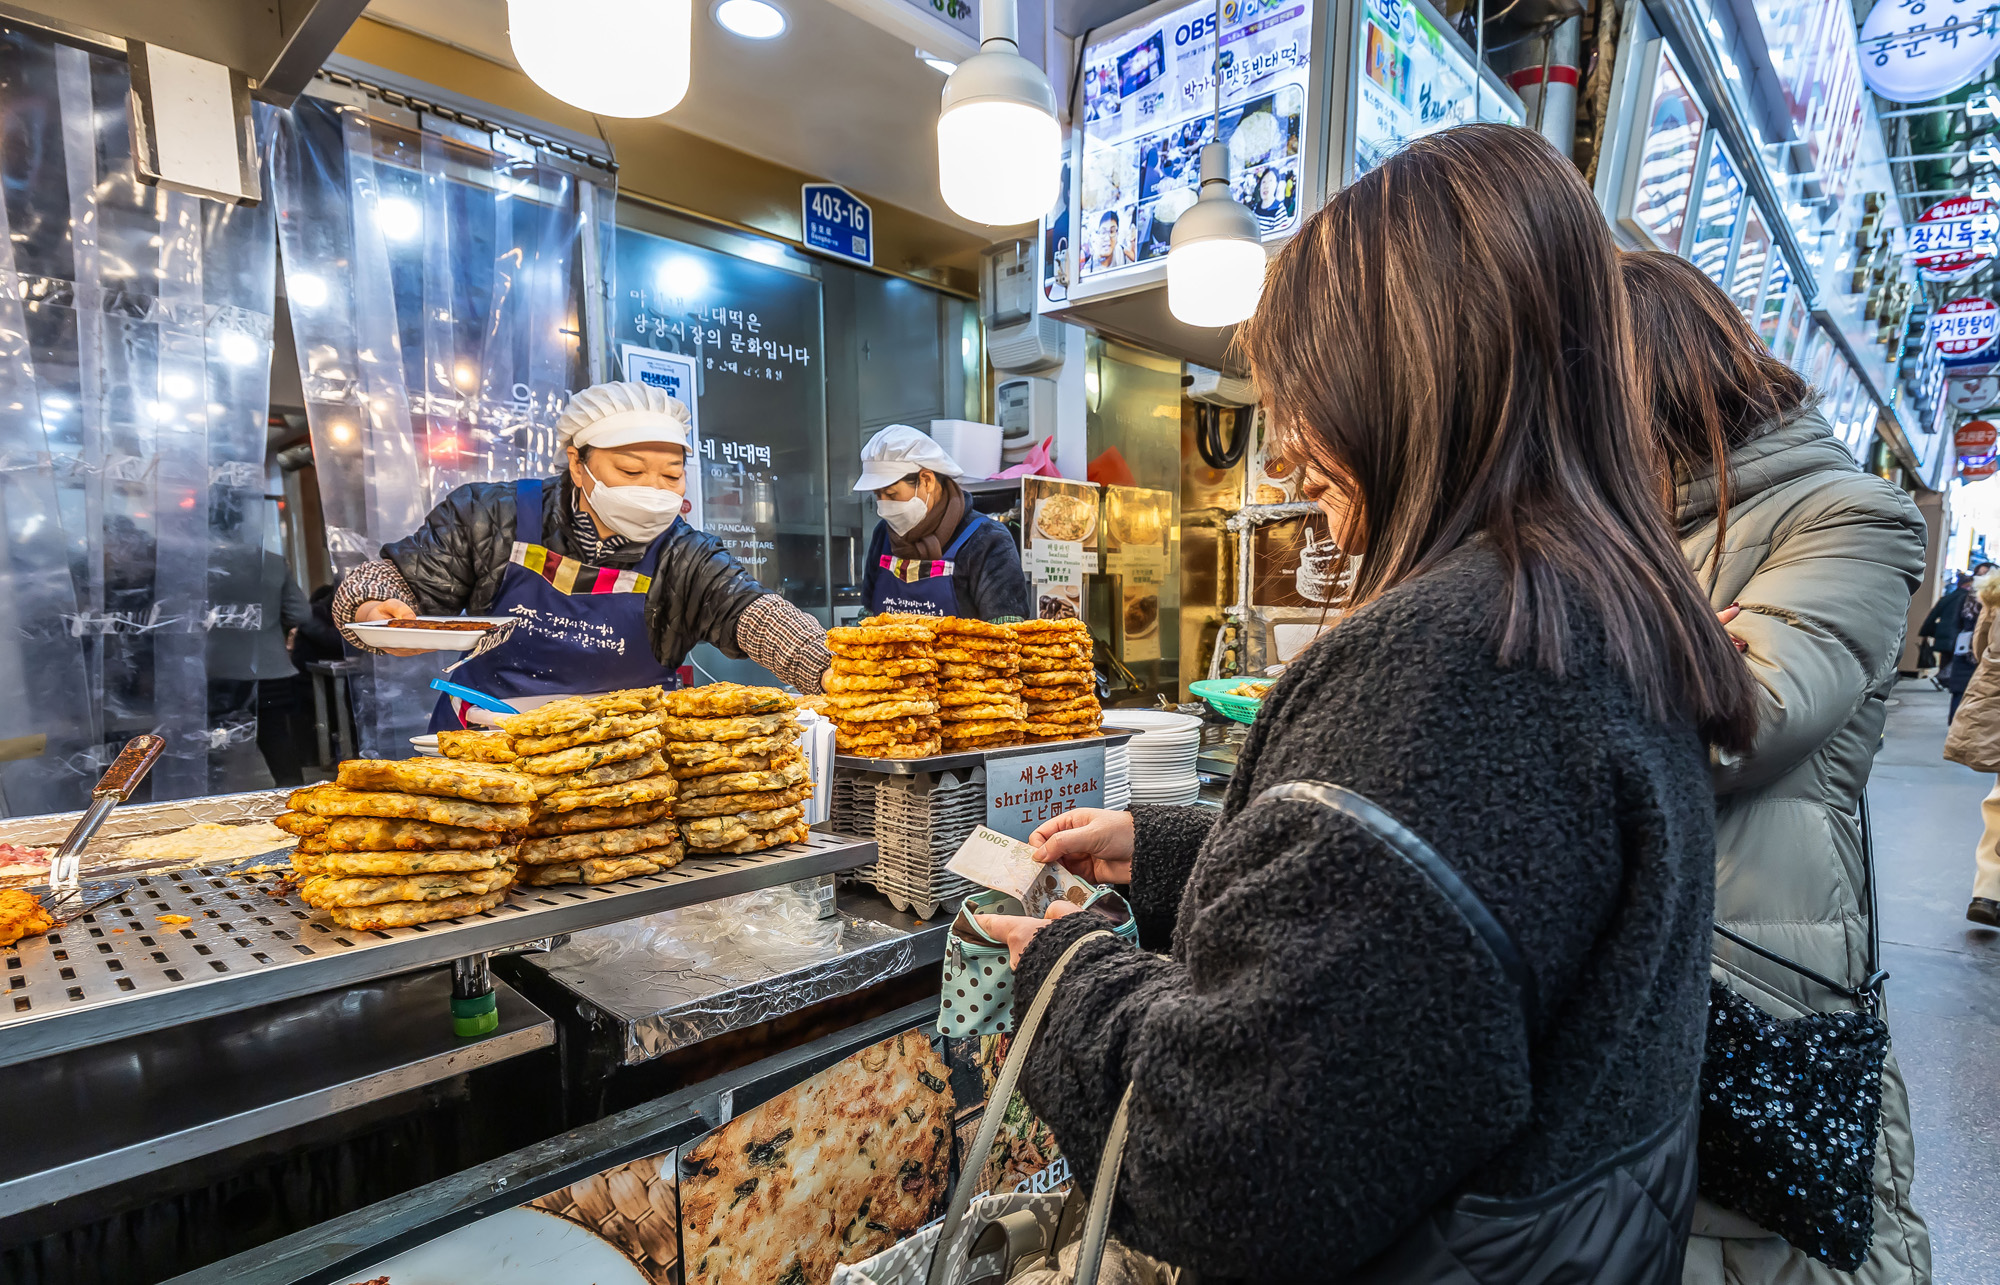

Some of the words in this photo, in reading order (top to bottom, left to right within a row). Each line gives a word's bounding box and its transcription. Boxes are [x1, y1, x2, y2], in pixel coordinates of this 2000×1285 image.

[1174, 12, 1216, 46] OBS
[812, 191, 865, 231] 403-16
[730, 332, 811, 367] 문화입니다
[721, 441, 772, 469] 빈대떡
[718, 523, 757, 534] PANCAKE
[740, 540, 775, 550] TARTARE
[1018, 759, 1079, 785] 새우완자
[994, 787, 1054, 809] shrimp
[1059, 777, 1099, 798] steak
[1021, 798, 1078, 824] エビ団子
[979, 830, 1010, 848] 5000
